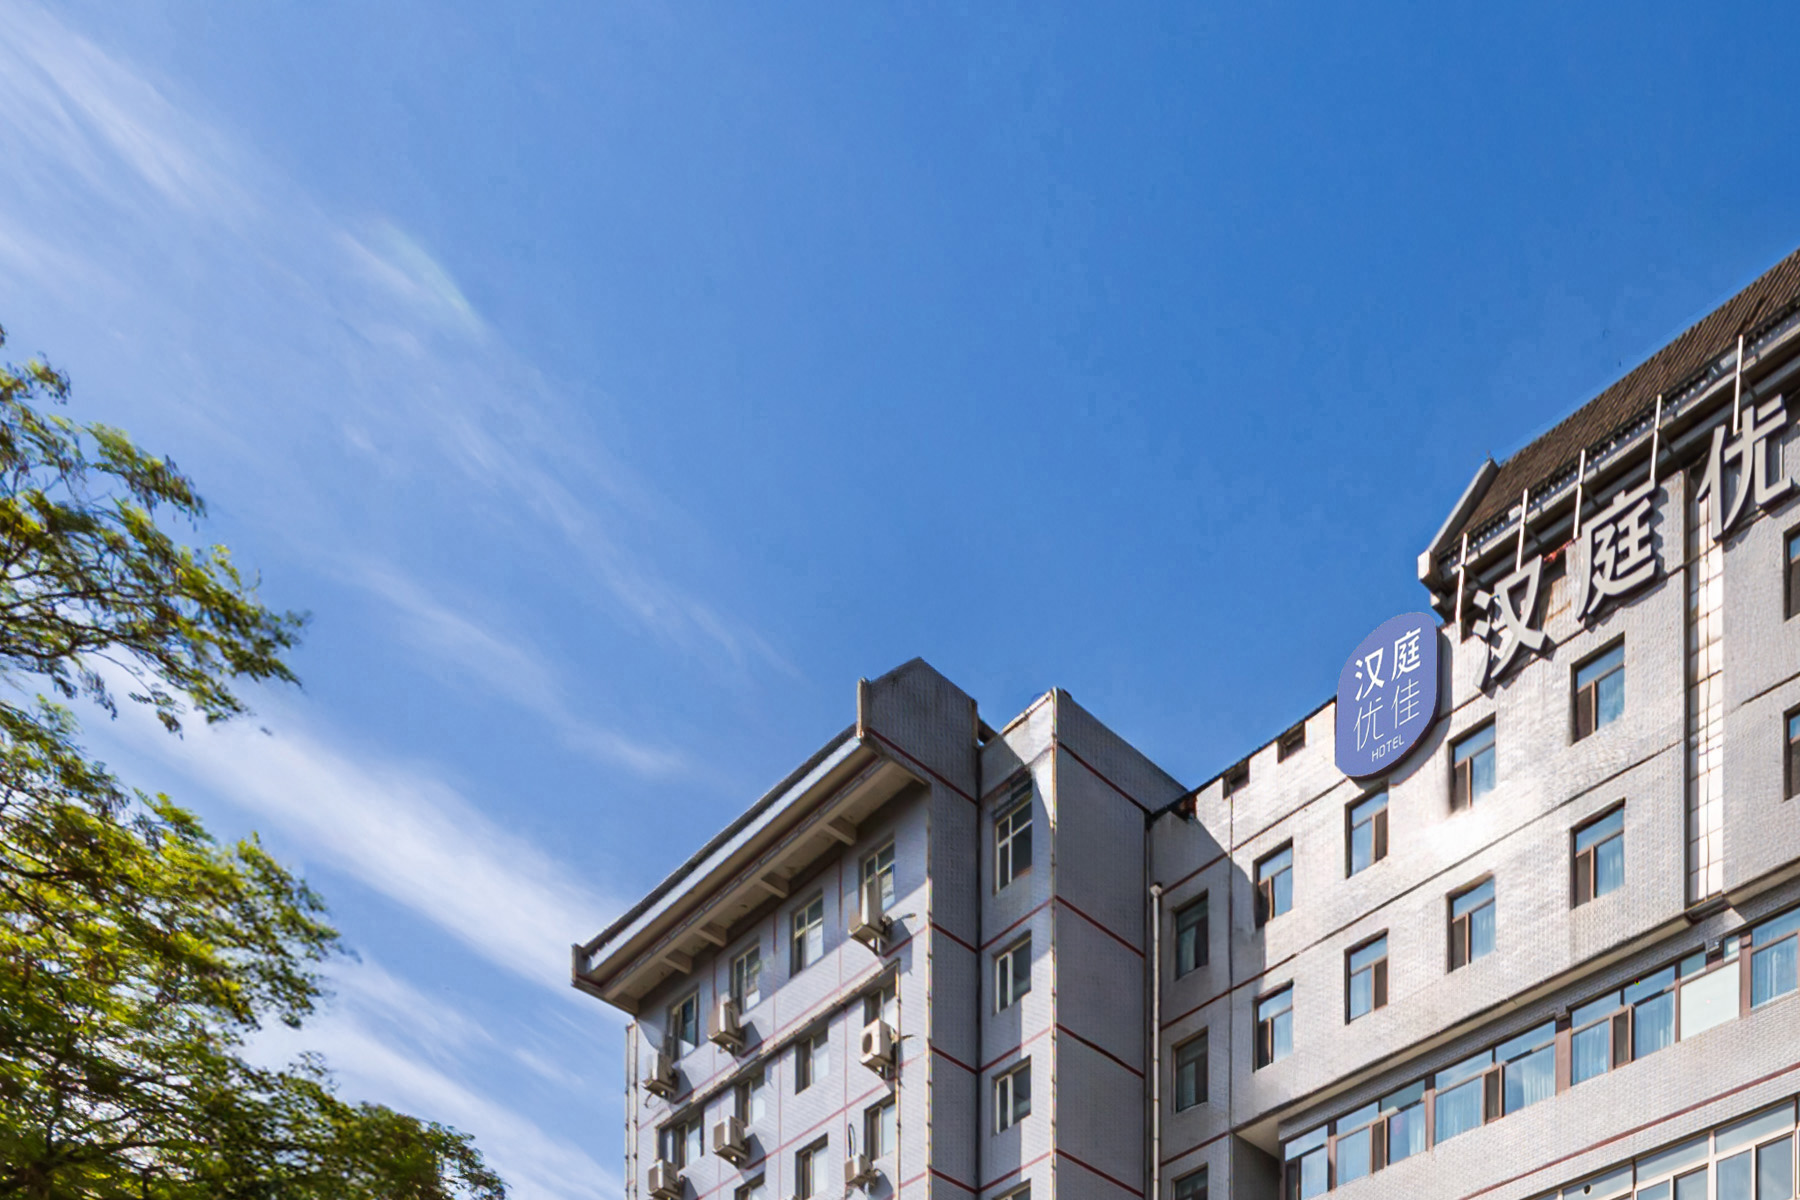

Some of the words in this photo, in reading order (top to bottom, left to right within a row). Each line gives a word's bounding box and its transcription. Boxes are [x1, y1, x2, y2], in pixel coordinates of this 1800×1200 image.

[1355, 628, 1422, 702] 汉庭
[1354, 678, 1420, 752] 优佳
[1371, 734, 1405, 762] HOTEL
